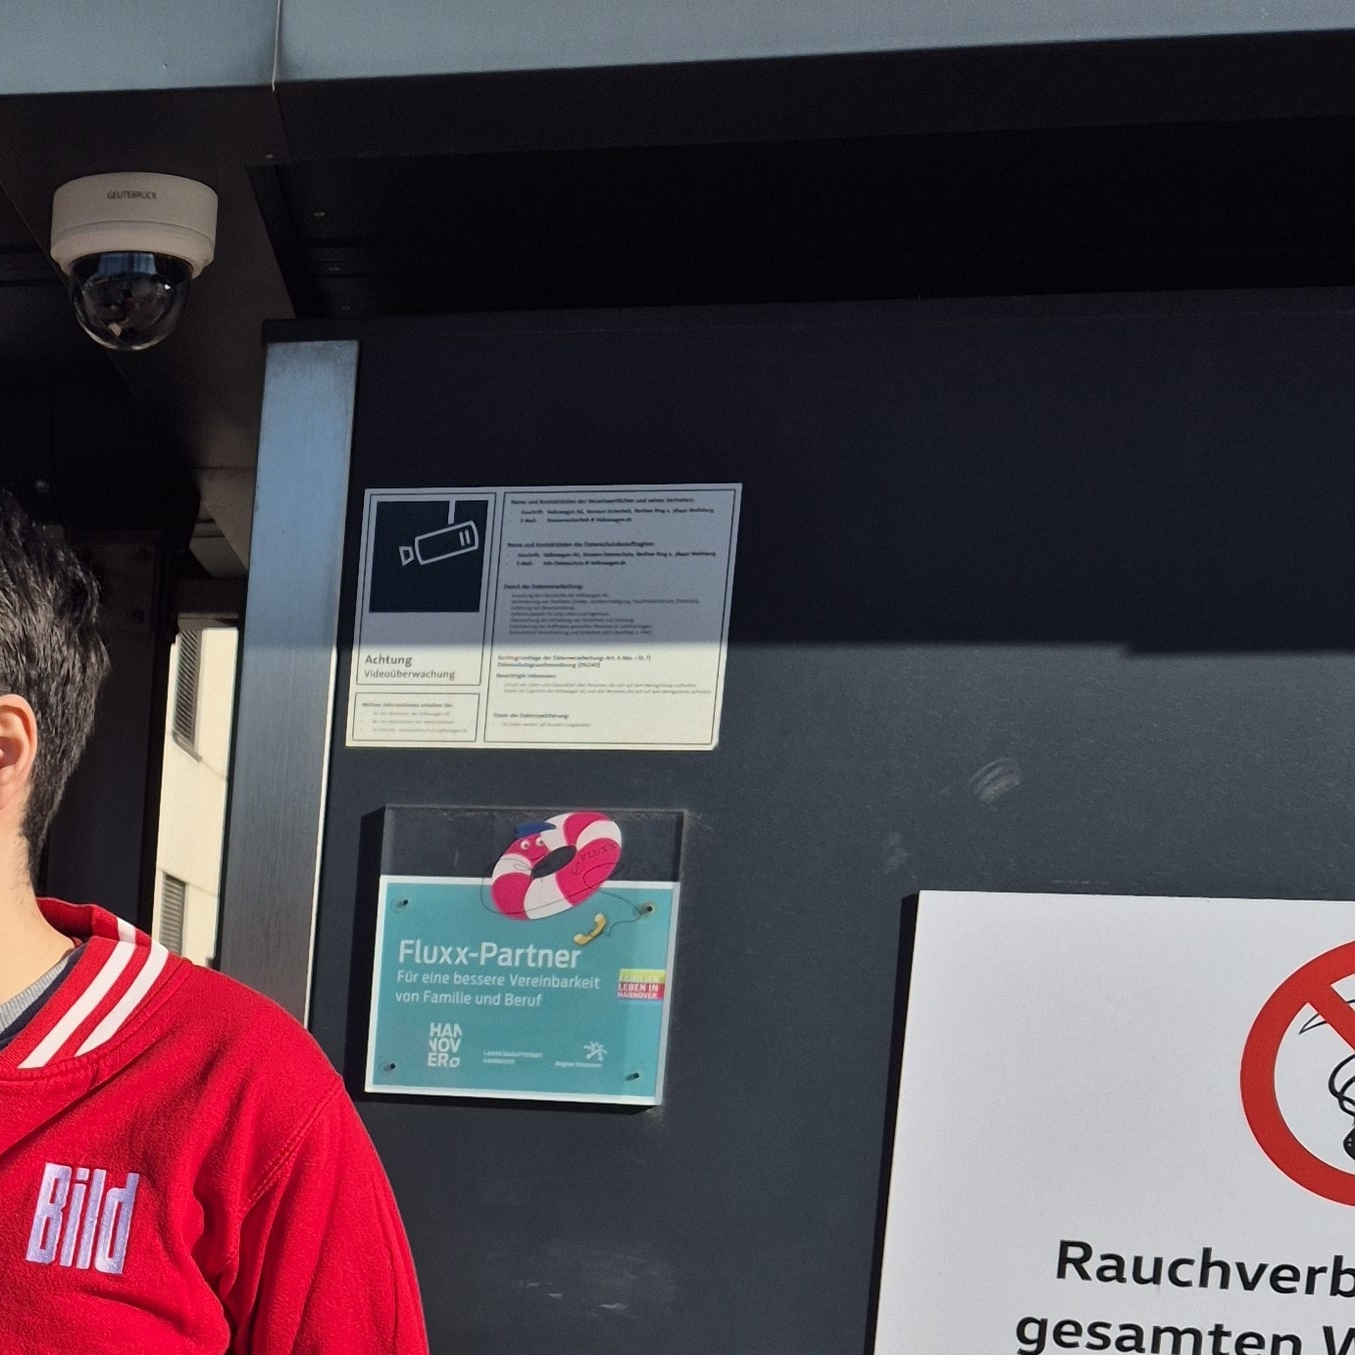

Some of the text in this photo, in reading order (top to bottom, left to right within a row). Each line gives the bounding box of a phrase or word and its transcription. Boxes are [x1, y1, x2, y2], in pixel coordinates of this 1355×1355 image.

[365, 654, 412, 667] Achtung
[365, 669, 455, 681] Videoüberwachung
[399, 939, 581, 969] Fluxx-Partner
[397, 969, 600, 989] Für eine bessere Vereinbarkeit
[648, 983, 659, 992] IN
[395, 990, 542, 1008] von Familie und Beruf
[26, 1162, 140, 1275] Bild
[1055, 1238, 1355, 1298] Rauchverb
